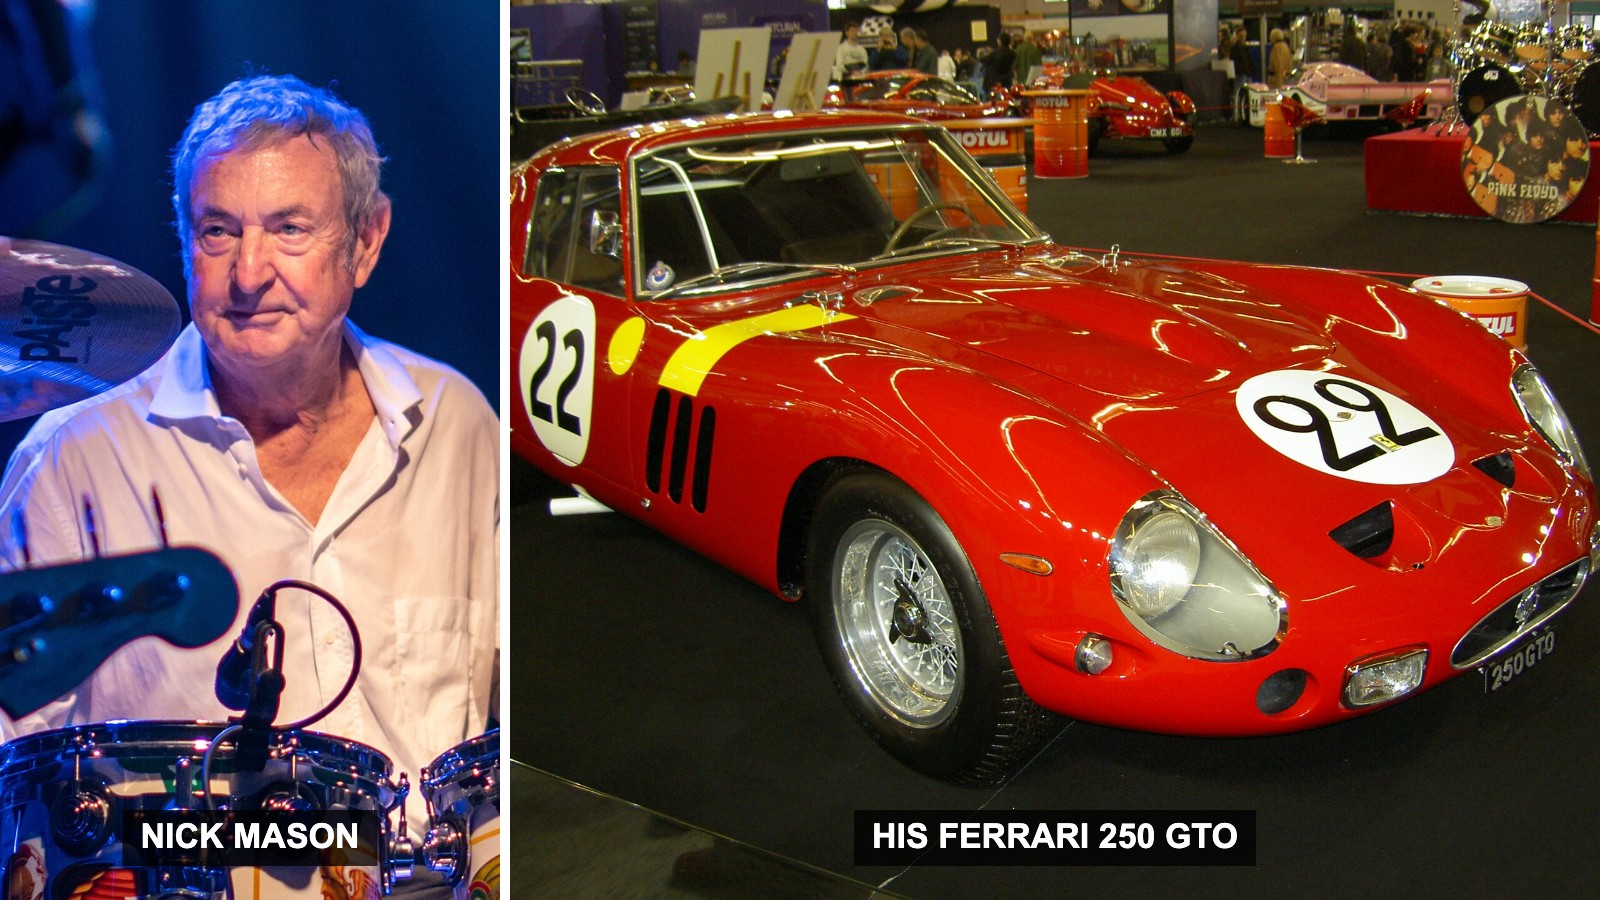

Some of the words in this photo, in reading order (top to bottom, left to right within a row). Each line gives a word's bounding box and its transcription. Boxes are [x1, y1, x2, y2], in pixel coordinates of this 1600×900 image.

[1150, 128, 1167, 137] CMX
[1520, 184, 1559, 199] FLOYD
[1477, 316, 1514, 335] TUL
[530, 320, 586, 437] 22
[1253, 378, 1441, 472] 22
